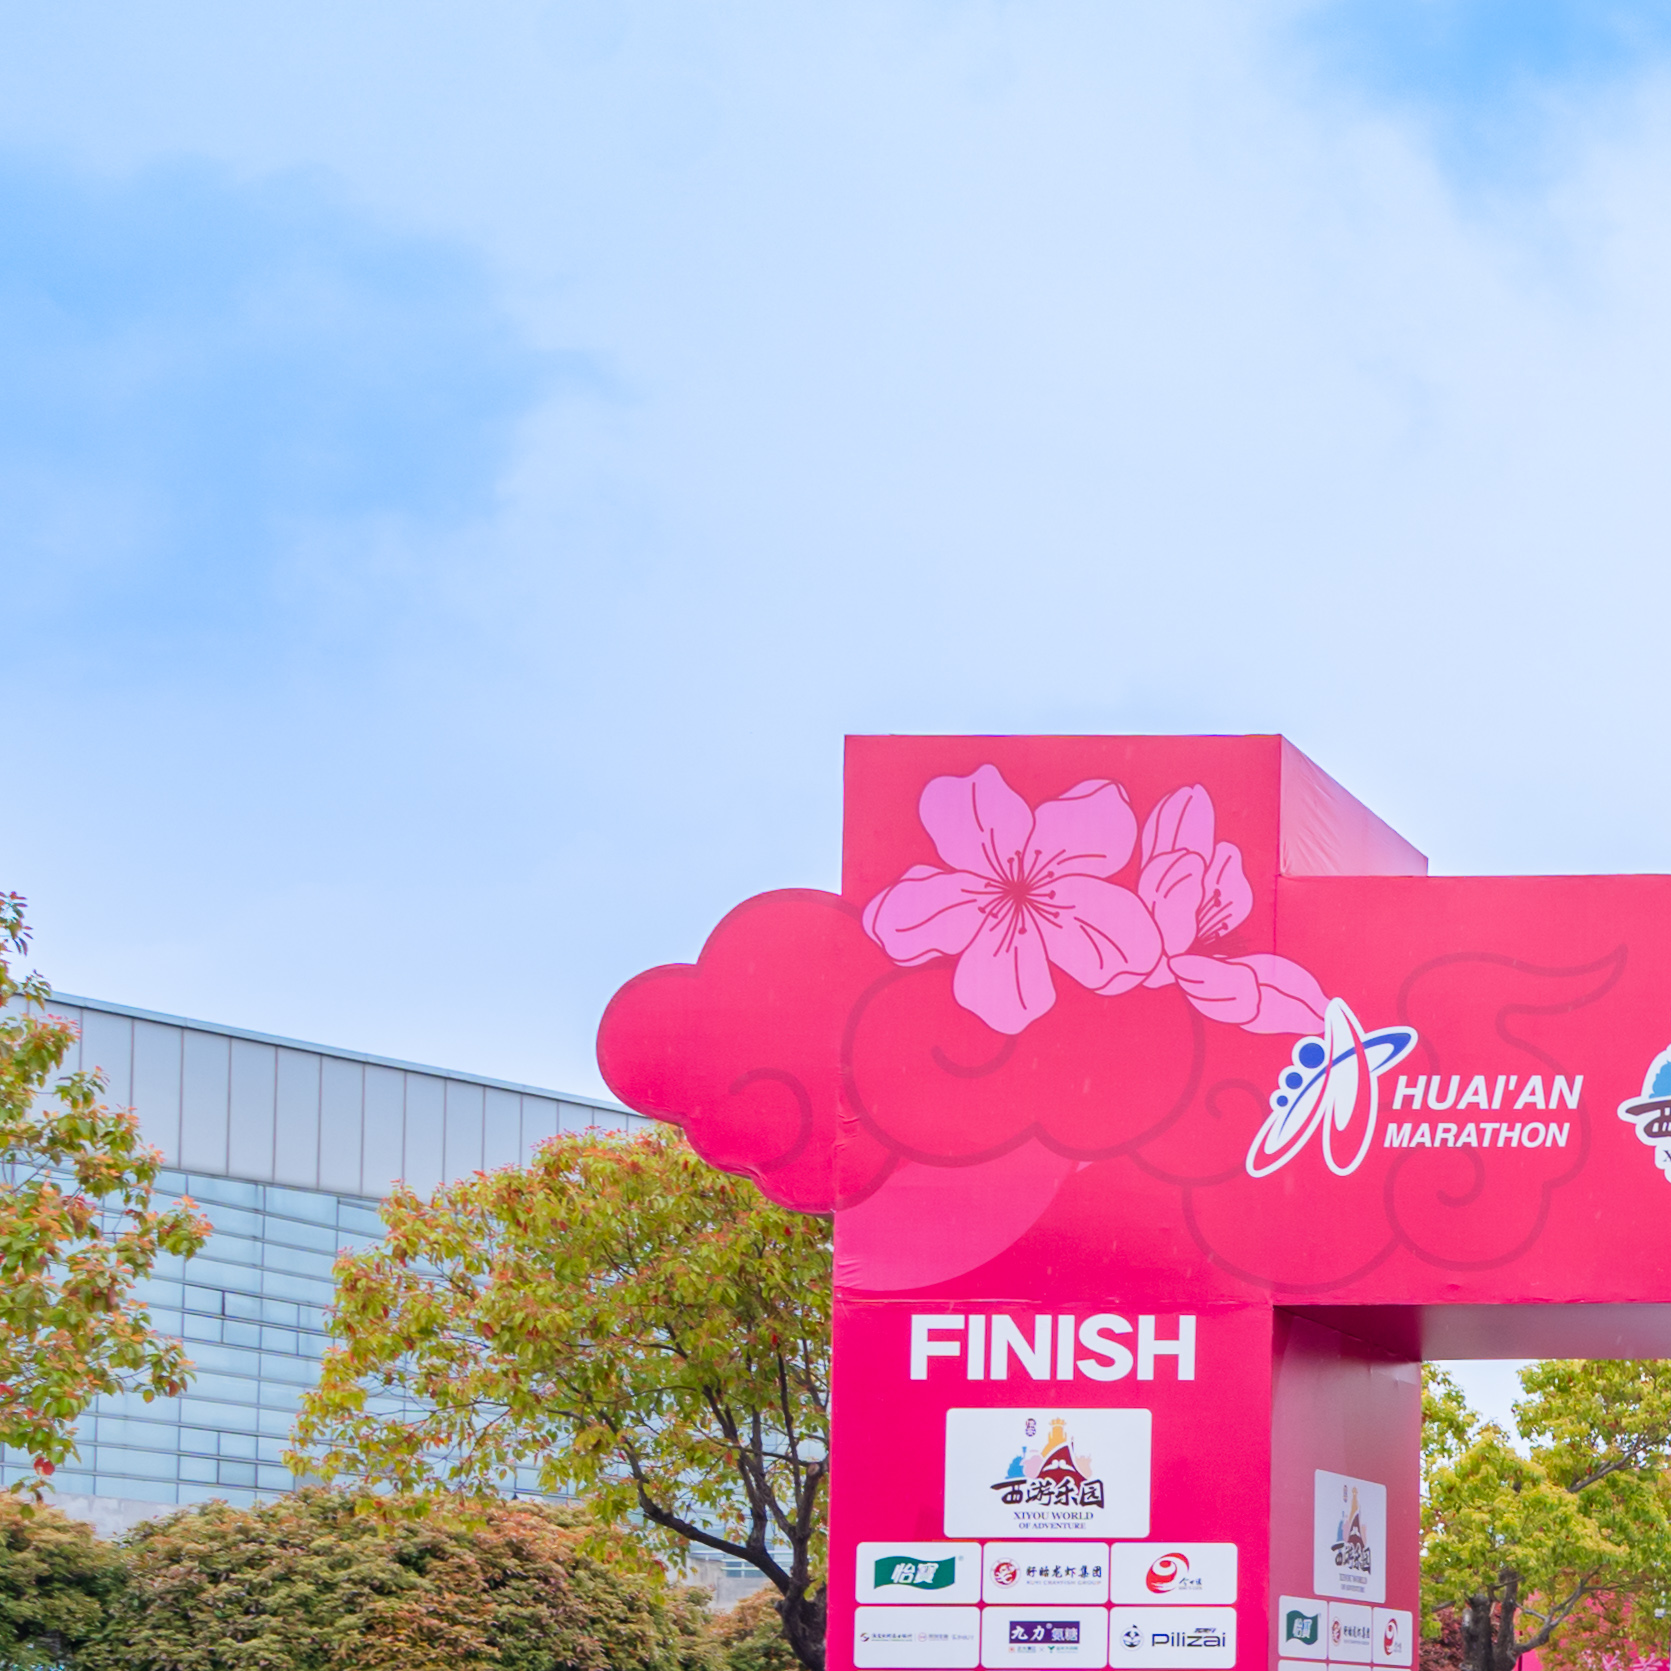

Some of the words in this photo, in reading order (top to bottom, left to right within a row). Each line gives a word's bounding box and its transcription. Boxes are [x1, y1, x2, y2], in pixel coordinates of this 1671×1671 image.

[1392, 1075, 1584, 1110] HUAI'AN
[1384, 1123, 1569, 1148] MARATHON
[910, 1313, 1197, 1382] FINISH
[990, 1479, 1105, 1509] 西游乐园
[1013, 1511, 1049, 1521] XIYOU
[1051, 1511, 1094, 1521] WORLD
[1034, 1522, 1087, 1530] ADVENTURE
[1151, 1632, 1226, 1647] Pilizai
